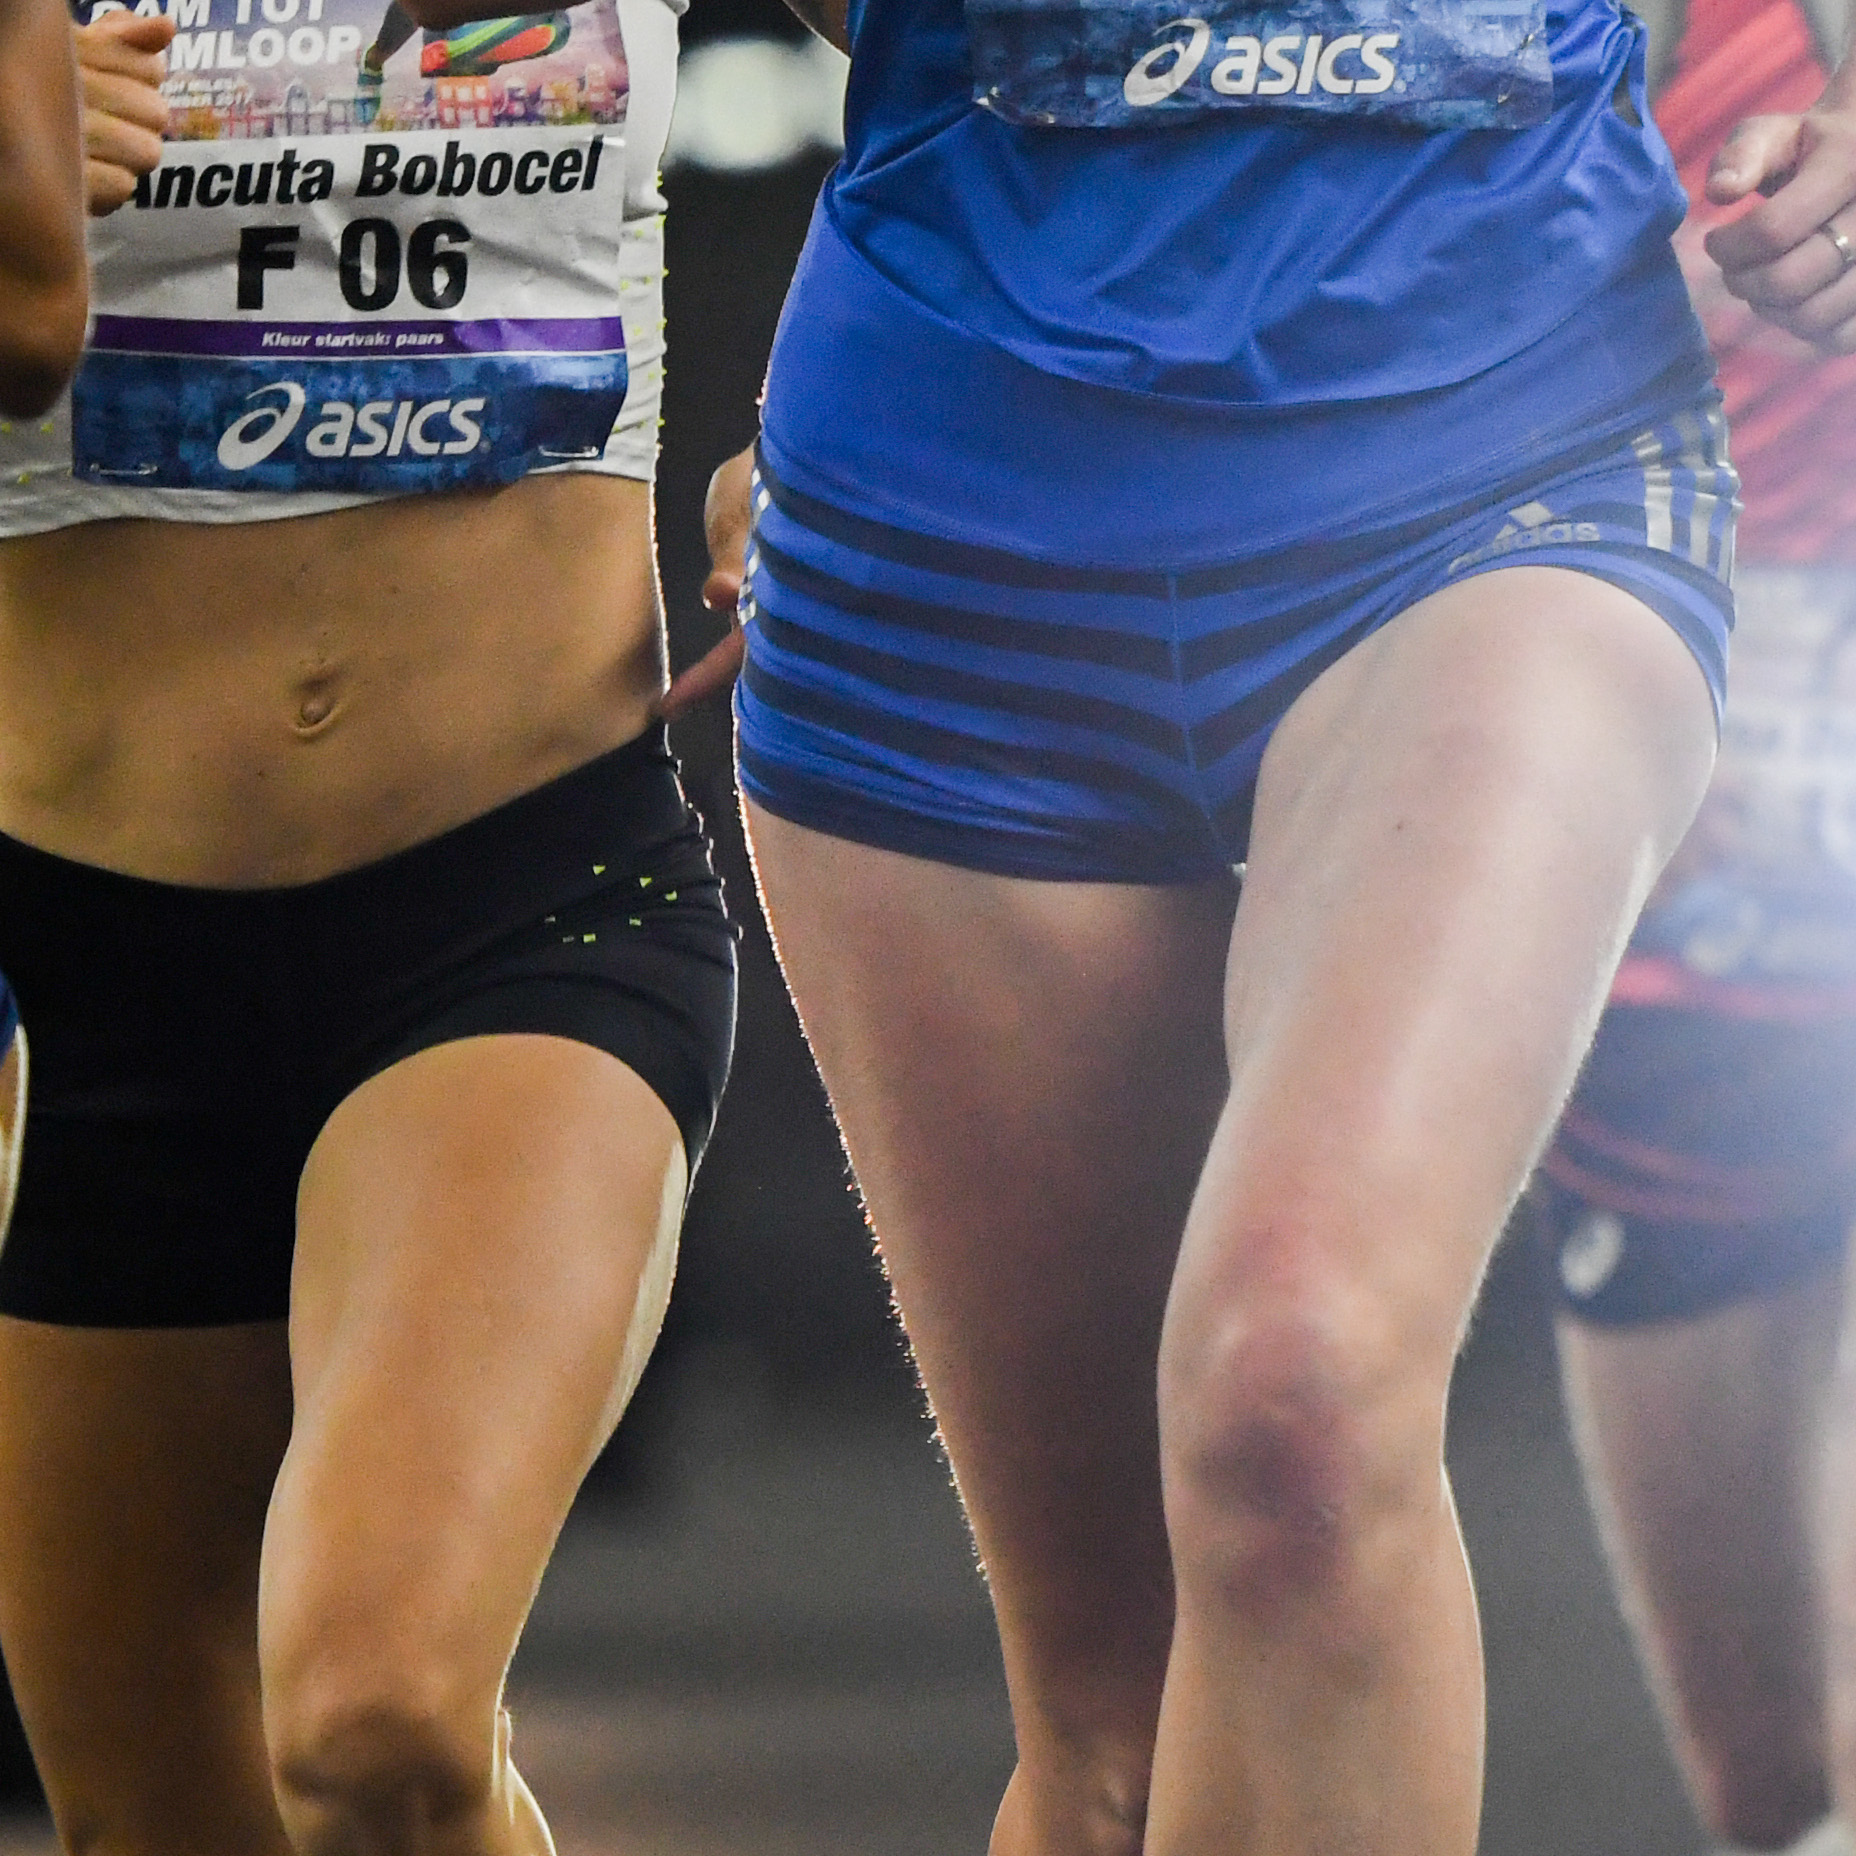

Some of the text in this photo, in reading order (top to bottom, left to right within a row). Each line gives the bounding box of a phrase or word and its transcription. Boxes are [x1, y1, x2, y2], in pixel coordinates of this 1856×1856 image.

[158, 24, 362, 71] MLOOP
[355, 133, 603, 198] Bobocel
[237, 217, 471, 312] F 06
